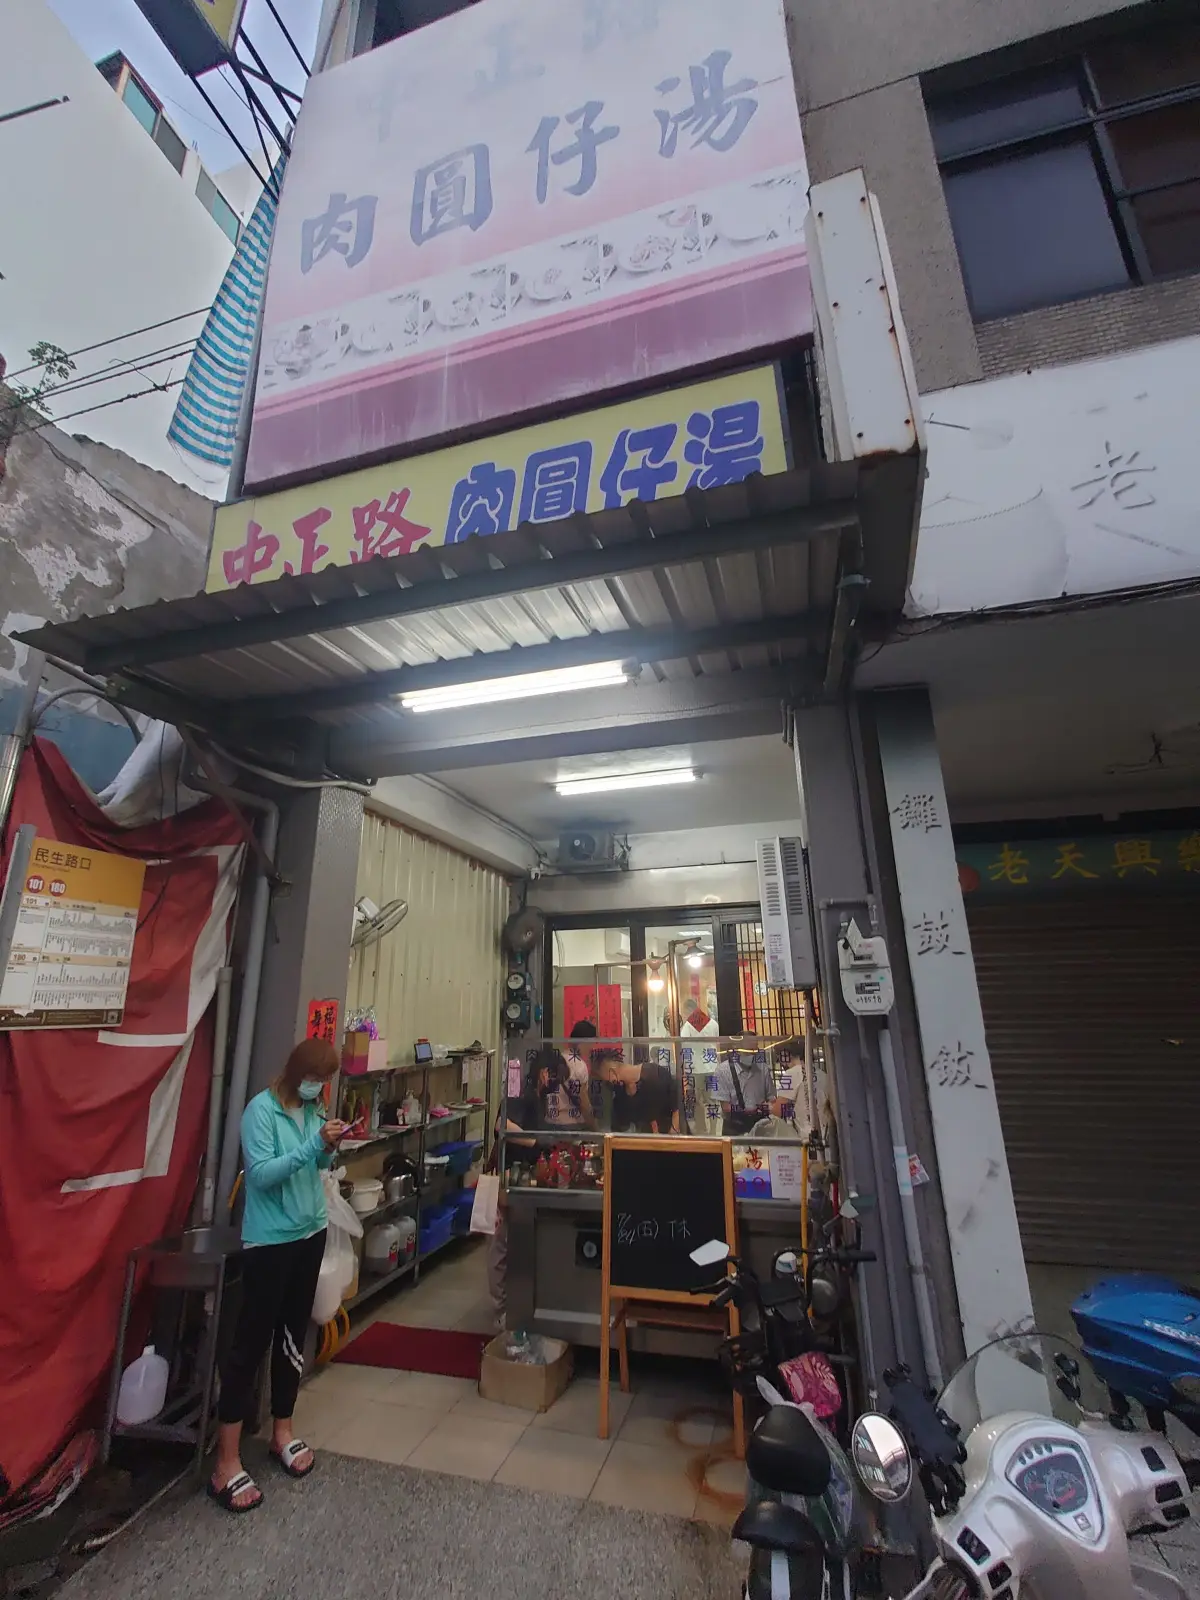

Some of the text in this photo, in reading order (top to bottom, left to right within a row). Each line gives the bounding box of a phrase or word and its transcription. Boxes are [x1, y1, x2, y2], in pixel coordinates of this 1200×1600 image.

[300, 50, 760, 276] 肉圓仔湯
[35, 847, 93, 871] 民生路口
[29, 878, 44, 890] 101
[702, 1047, 721, 1120] 燙青菜
